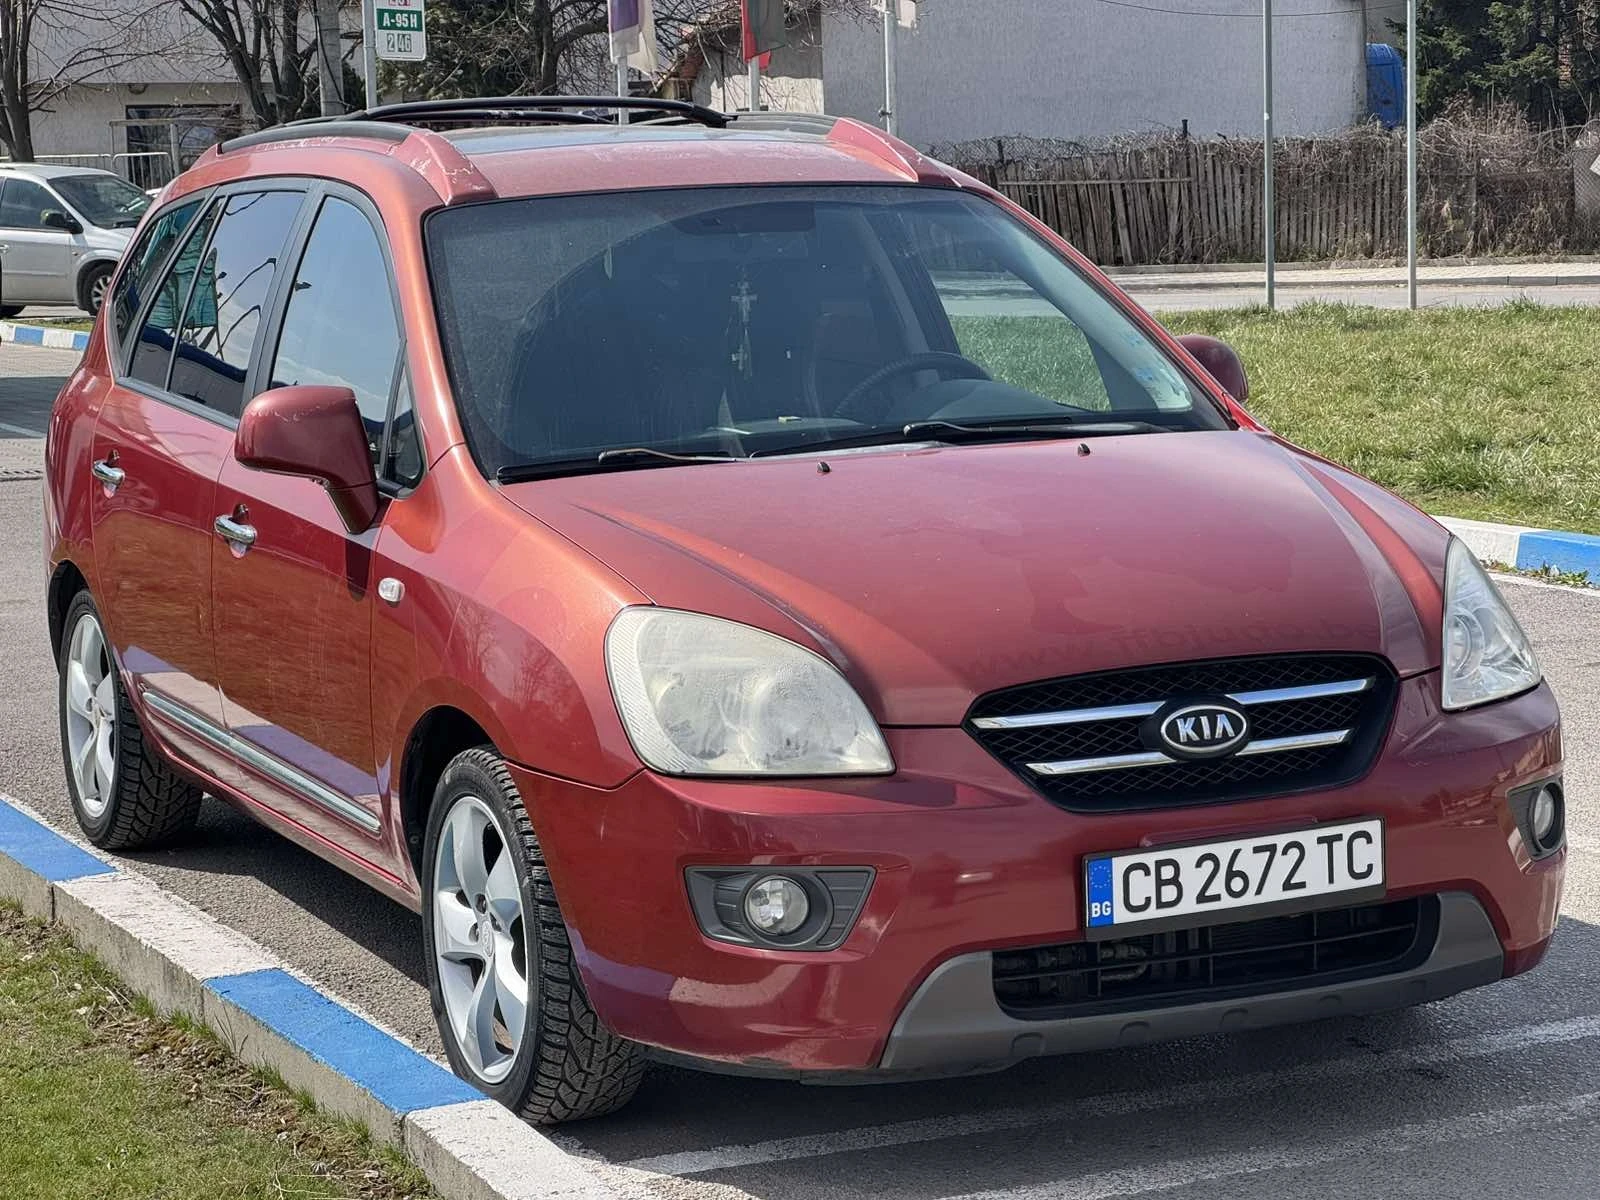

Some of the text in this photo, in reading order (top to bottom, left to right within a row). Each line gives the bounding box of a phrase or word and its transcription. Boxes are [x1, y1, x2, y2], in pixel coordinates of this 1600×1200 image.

[1176, 713, 1235, 743] KIA
[1122, 830, 1373, 913] CB 2672 TC
[1091, 901, 1111, 917] BG
